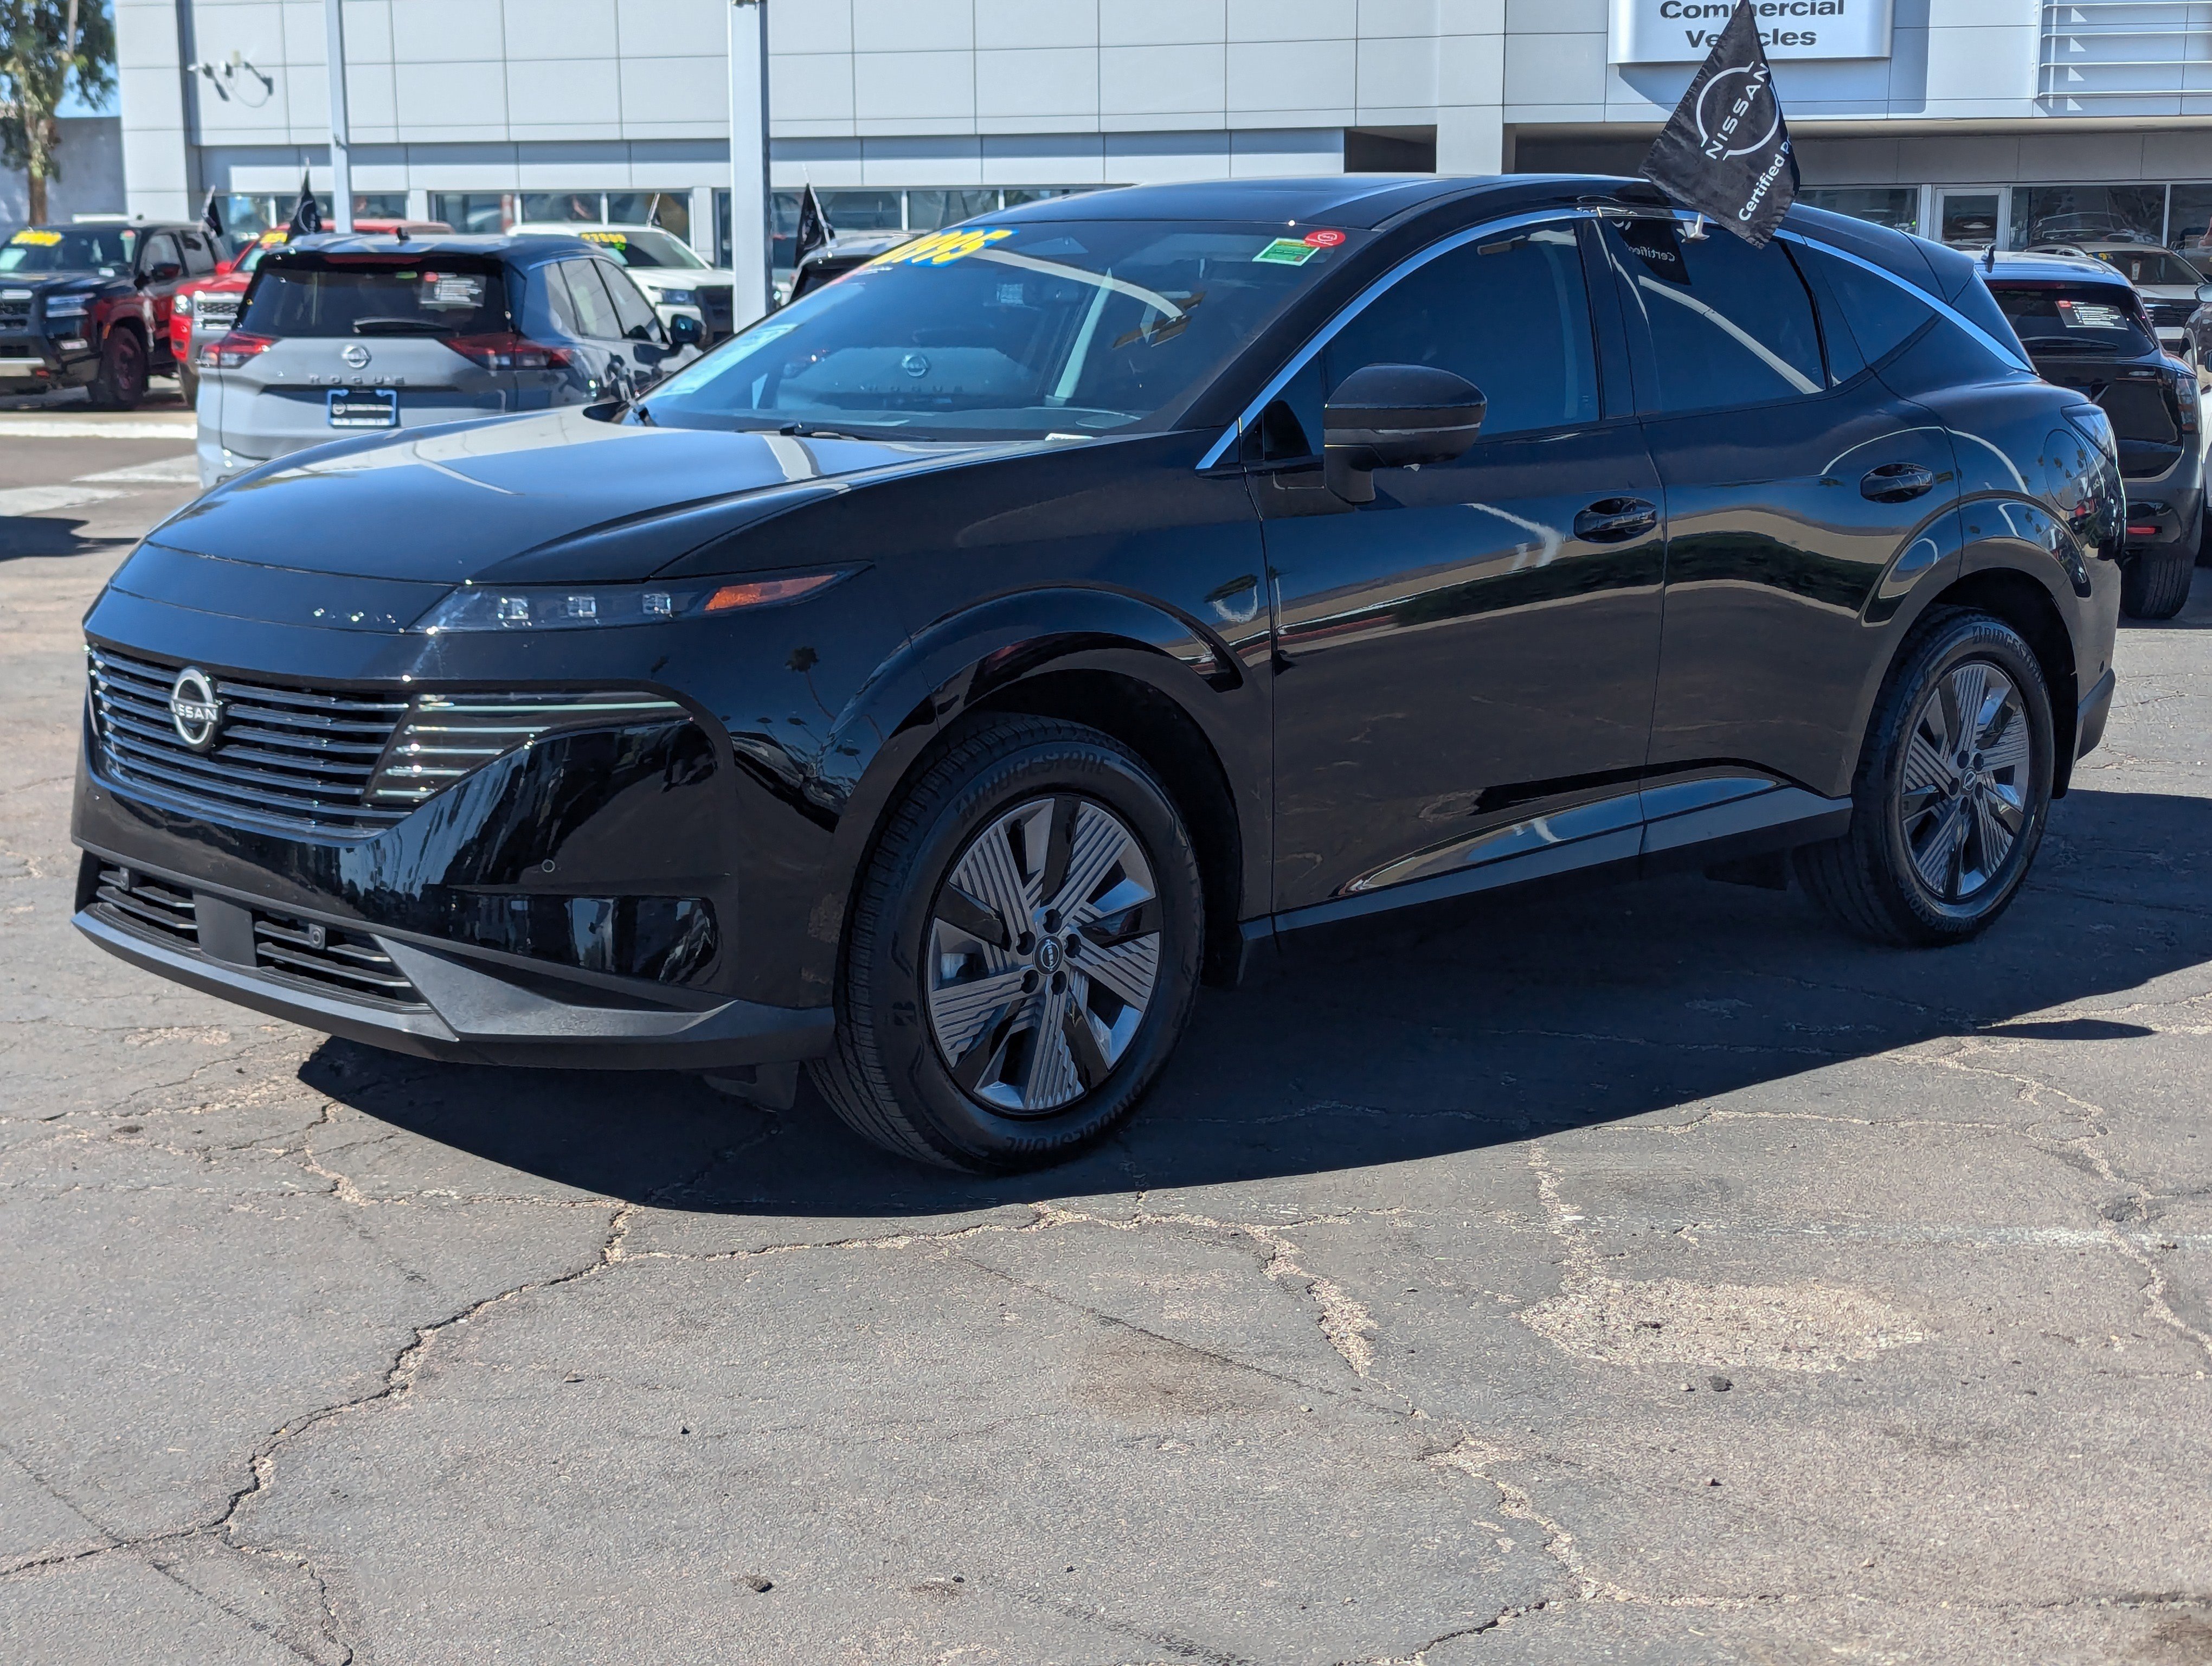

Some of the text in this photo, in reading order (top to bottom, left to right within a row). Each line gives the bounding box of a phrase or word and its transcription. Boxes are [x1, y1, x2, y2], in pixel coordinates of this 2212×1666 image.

[1685, 28, 1817, 48] Vecles
[1706, 62, 1769, 159] NISSAN
[1738, 154, 1785, 221] Certified
